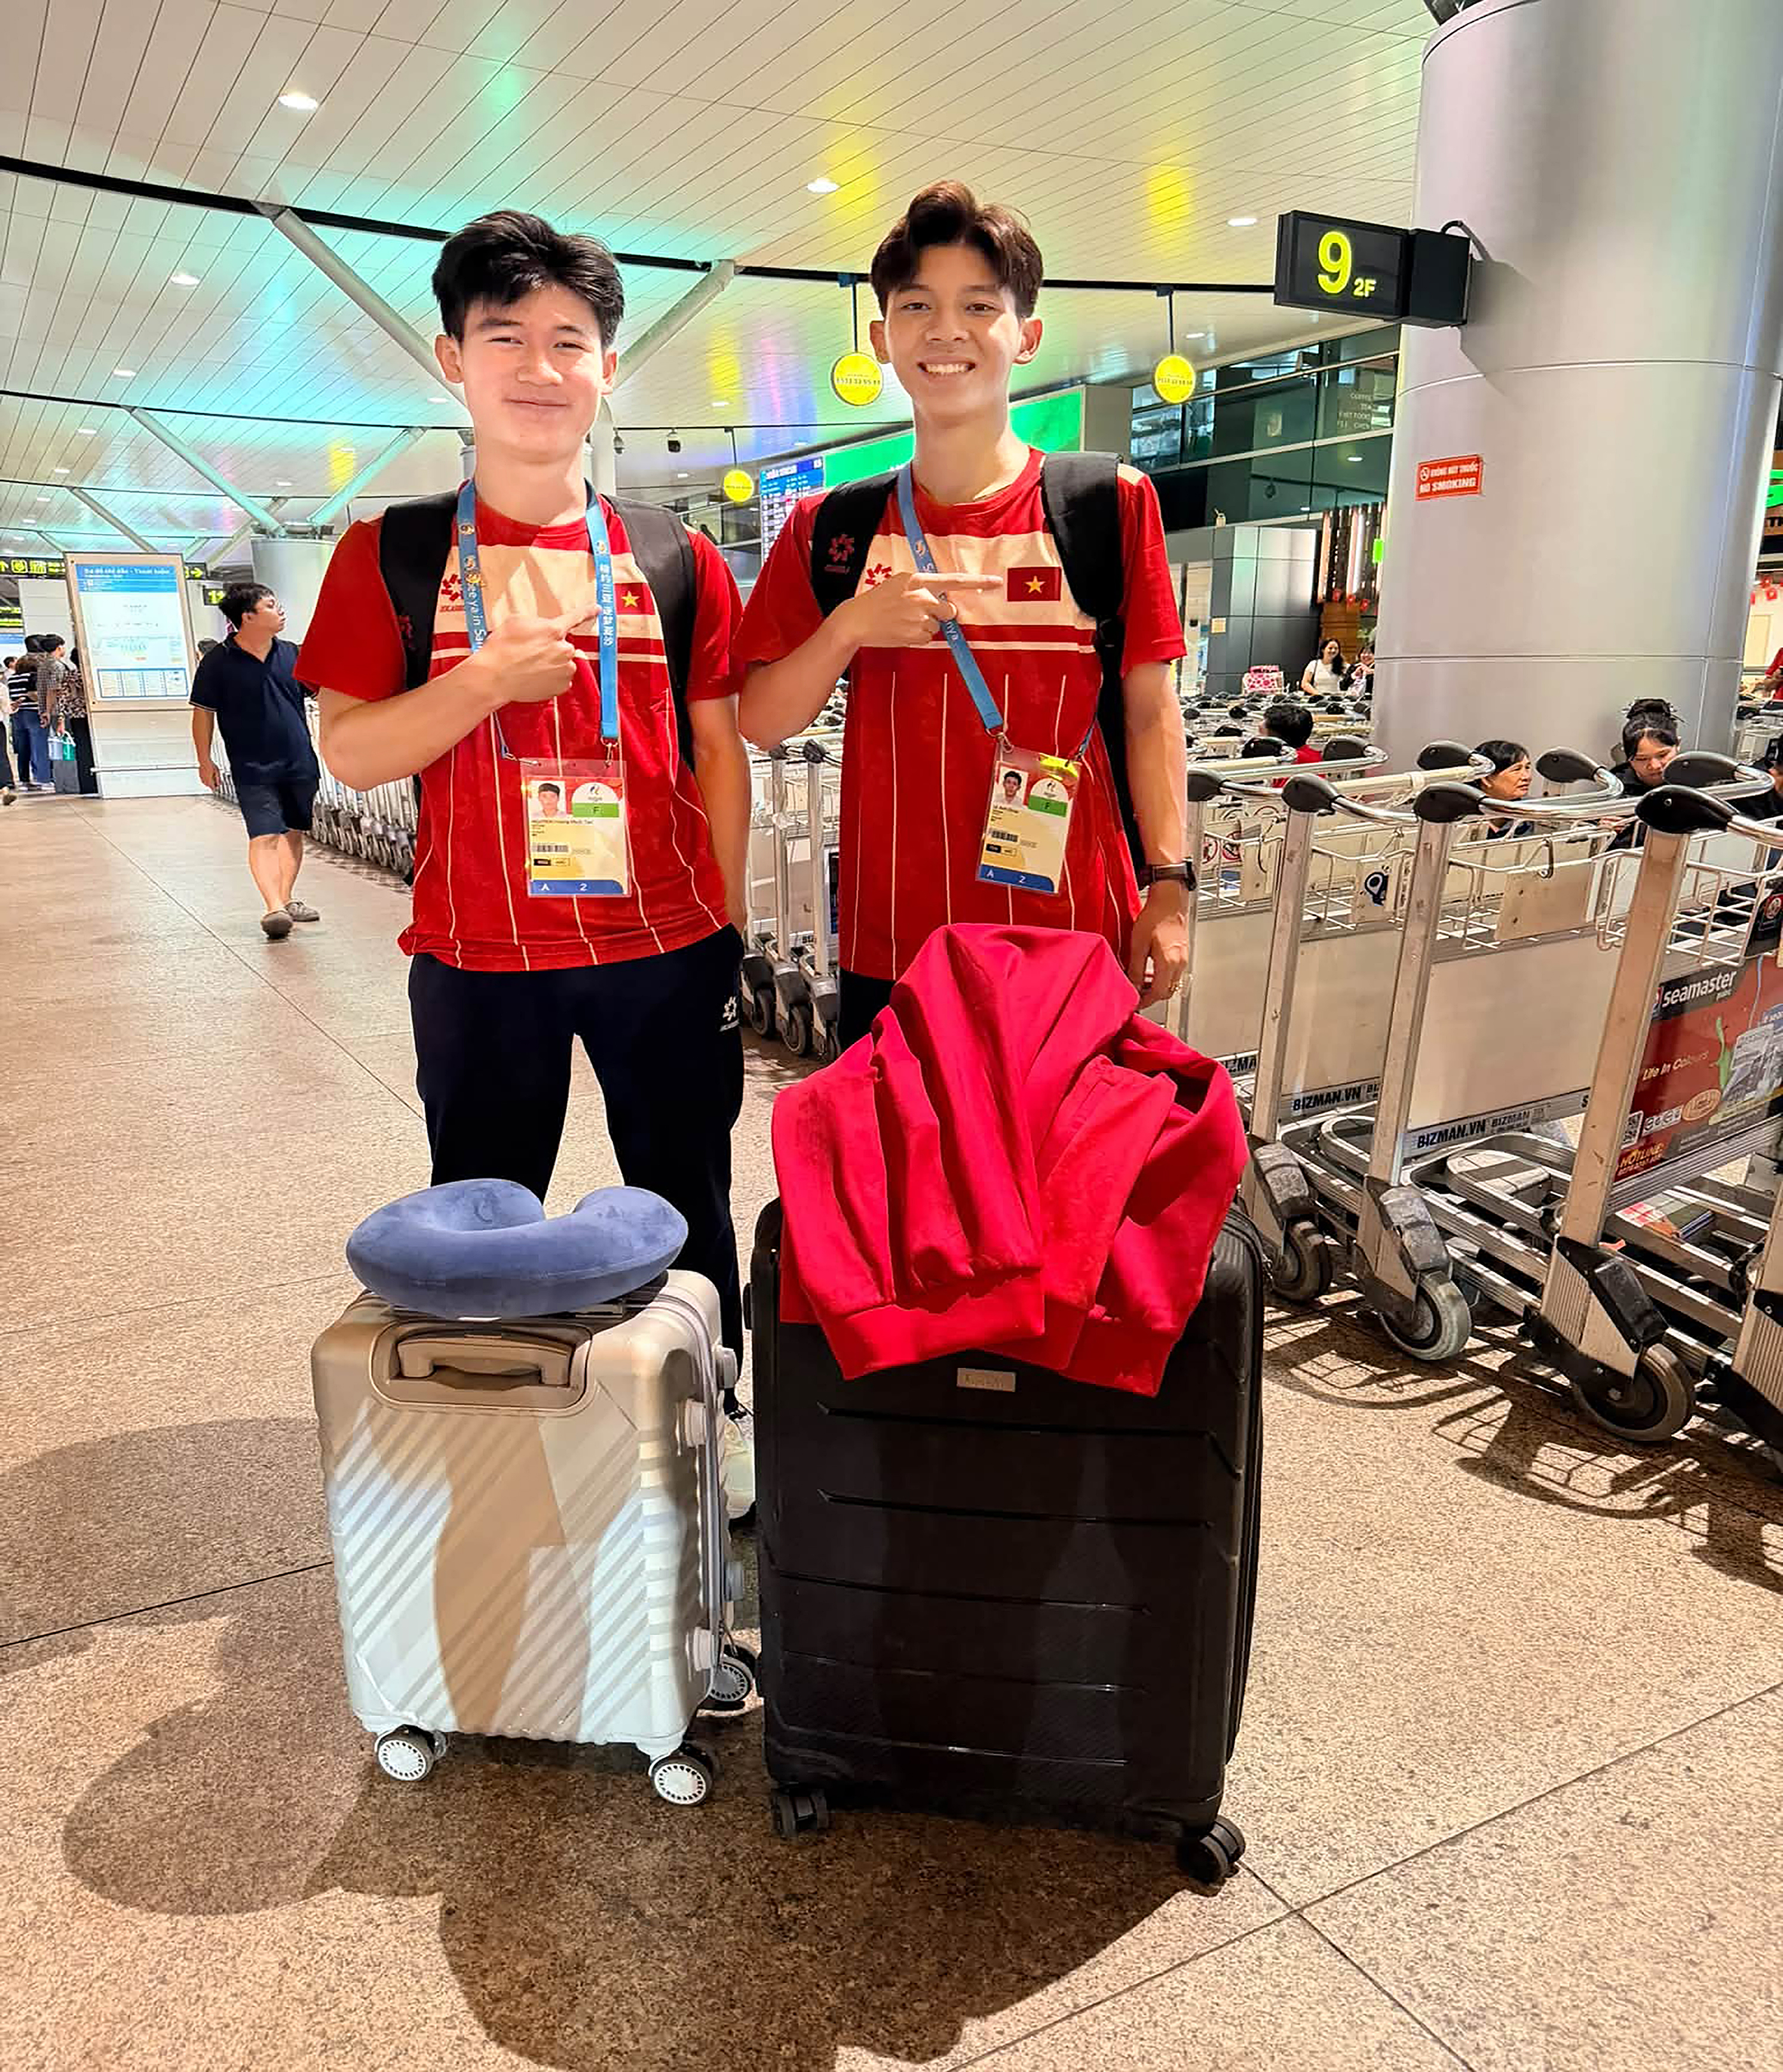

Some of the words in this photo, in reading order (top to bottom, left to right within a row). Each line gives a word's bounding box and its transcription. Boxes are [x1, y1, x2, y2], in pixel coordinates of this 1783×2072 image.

[1318, 231, 1352, 293] 9
[1353, 278, 1377, 297] 2F
[1432, 477, 1476, 491] SMOKING
[473, 615, 483, 625] in
[986, 869, 994, 879] A
[1019, 876, 1027, 884] 2
[1662, 971, 1737, 1008] seamaster
[1293, 1086, 1361, 1111] BIZMAN.VN
[1417, 1119, 1486, 1148] BIZMAN.VN
